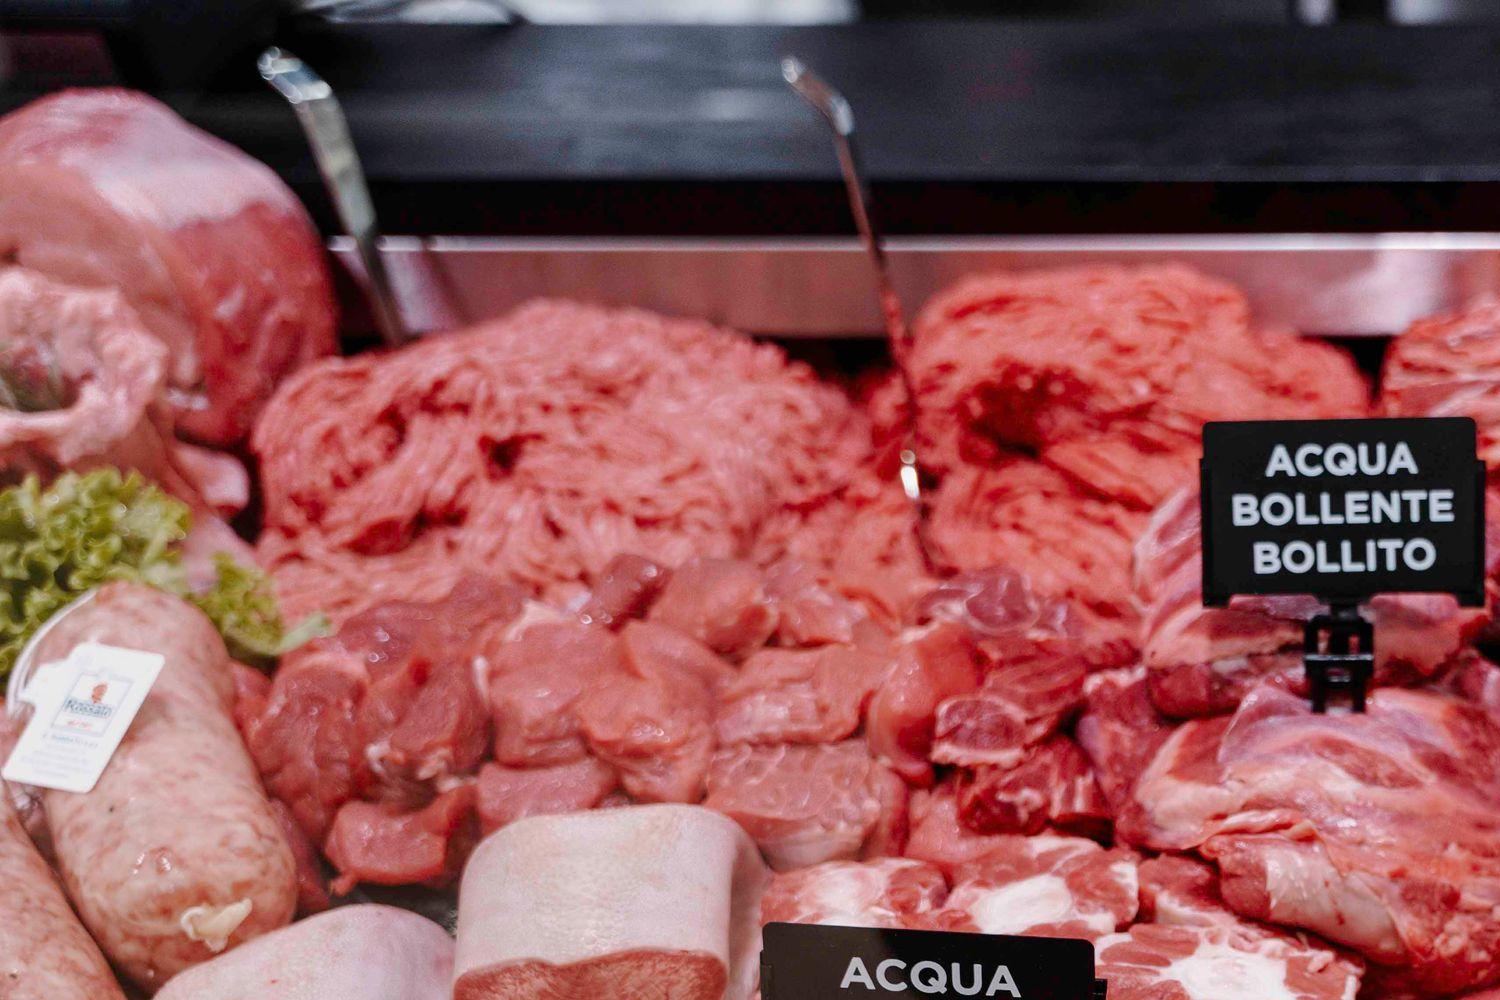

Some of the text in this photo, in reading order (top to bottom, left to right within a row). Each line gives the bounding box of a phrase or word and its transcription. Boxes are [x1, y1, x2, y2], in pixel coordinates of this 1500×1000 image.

[1266, 442, 1418, 477] ACQUA
[1232, 490, 1454, 526] BOLLENTE
[1254, 538, 1436, 574] BOLLITO
[840, 957, 1021, 997] ACQUA
